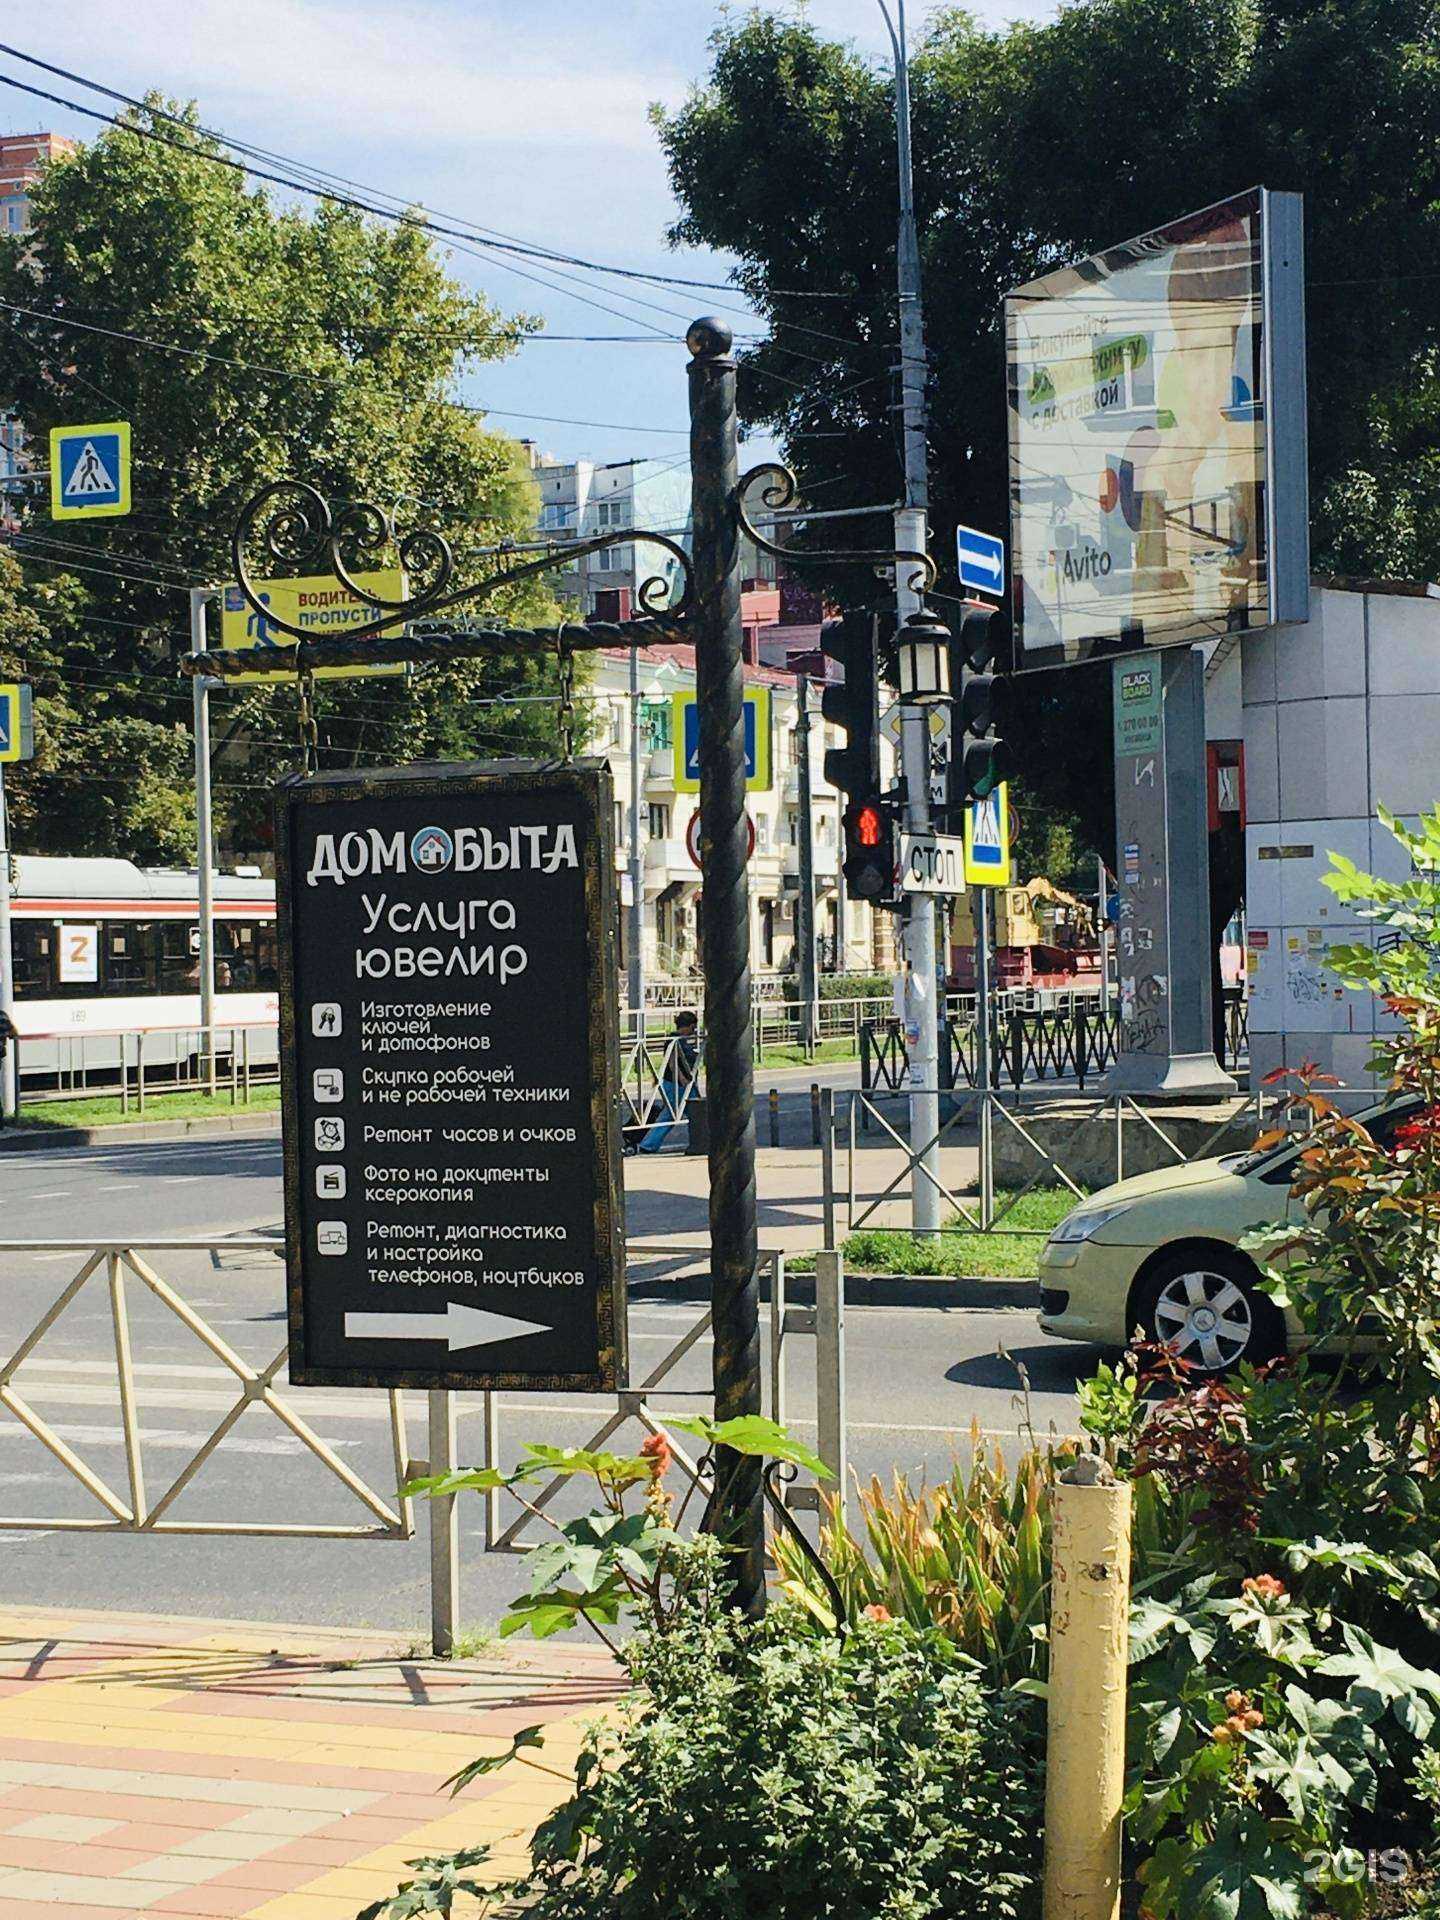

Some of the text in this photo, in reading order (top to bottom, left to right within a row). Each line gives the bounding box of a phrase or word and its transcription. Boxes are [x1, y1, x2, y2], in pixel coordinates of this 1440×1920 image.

[1063, 547, 1112, 585] Avito
[299, 608, 381, 626] ПРОПУСТИ
[306, 824, 579, 887] ДОМ БЫТА
[911, 845, 957, 887] СТОП
[361, 893, 516, 940] Услуга
[355, 944, 528, 986] ювелир
[361, 1001, 492, 1019] Изготовление
[361, 1016, 431, 1035] ключей
[361, 1034, 491, 1054] и домофонов
[362, 1064, 514, 1088] Скупка рабочей
[362, 1084, 570, 1107] и не рабочей техники
[363, 1125, 577, 1143] Ремонт часов и очков
[364, 1164, 549, 1185] Фото на документы
[365, 1188, 474, 1205] ксерокопия
[366, 1221, 567, 1242] Ремонт, диагностика
[366, 1243, 484, 1265] и настройка
[368, 1267, 585, 1288] телефонов, ноутбуков
